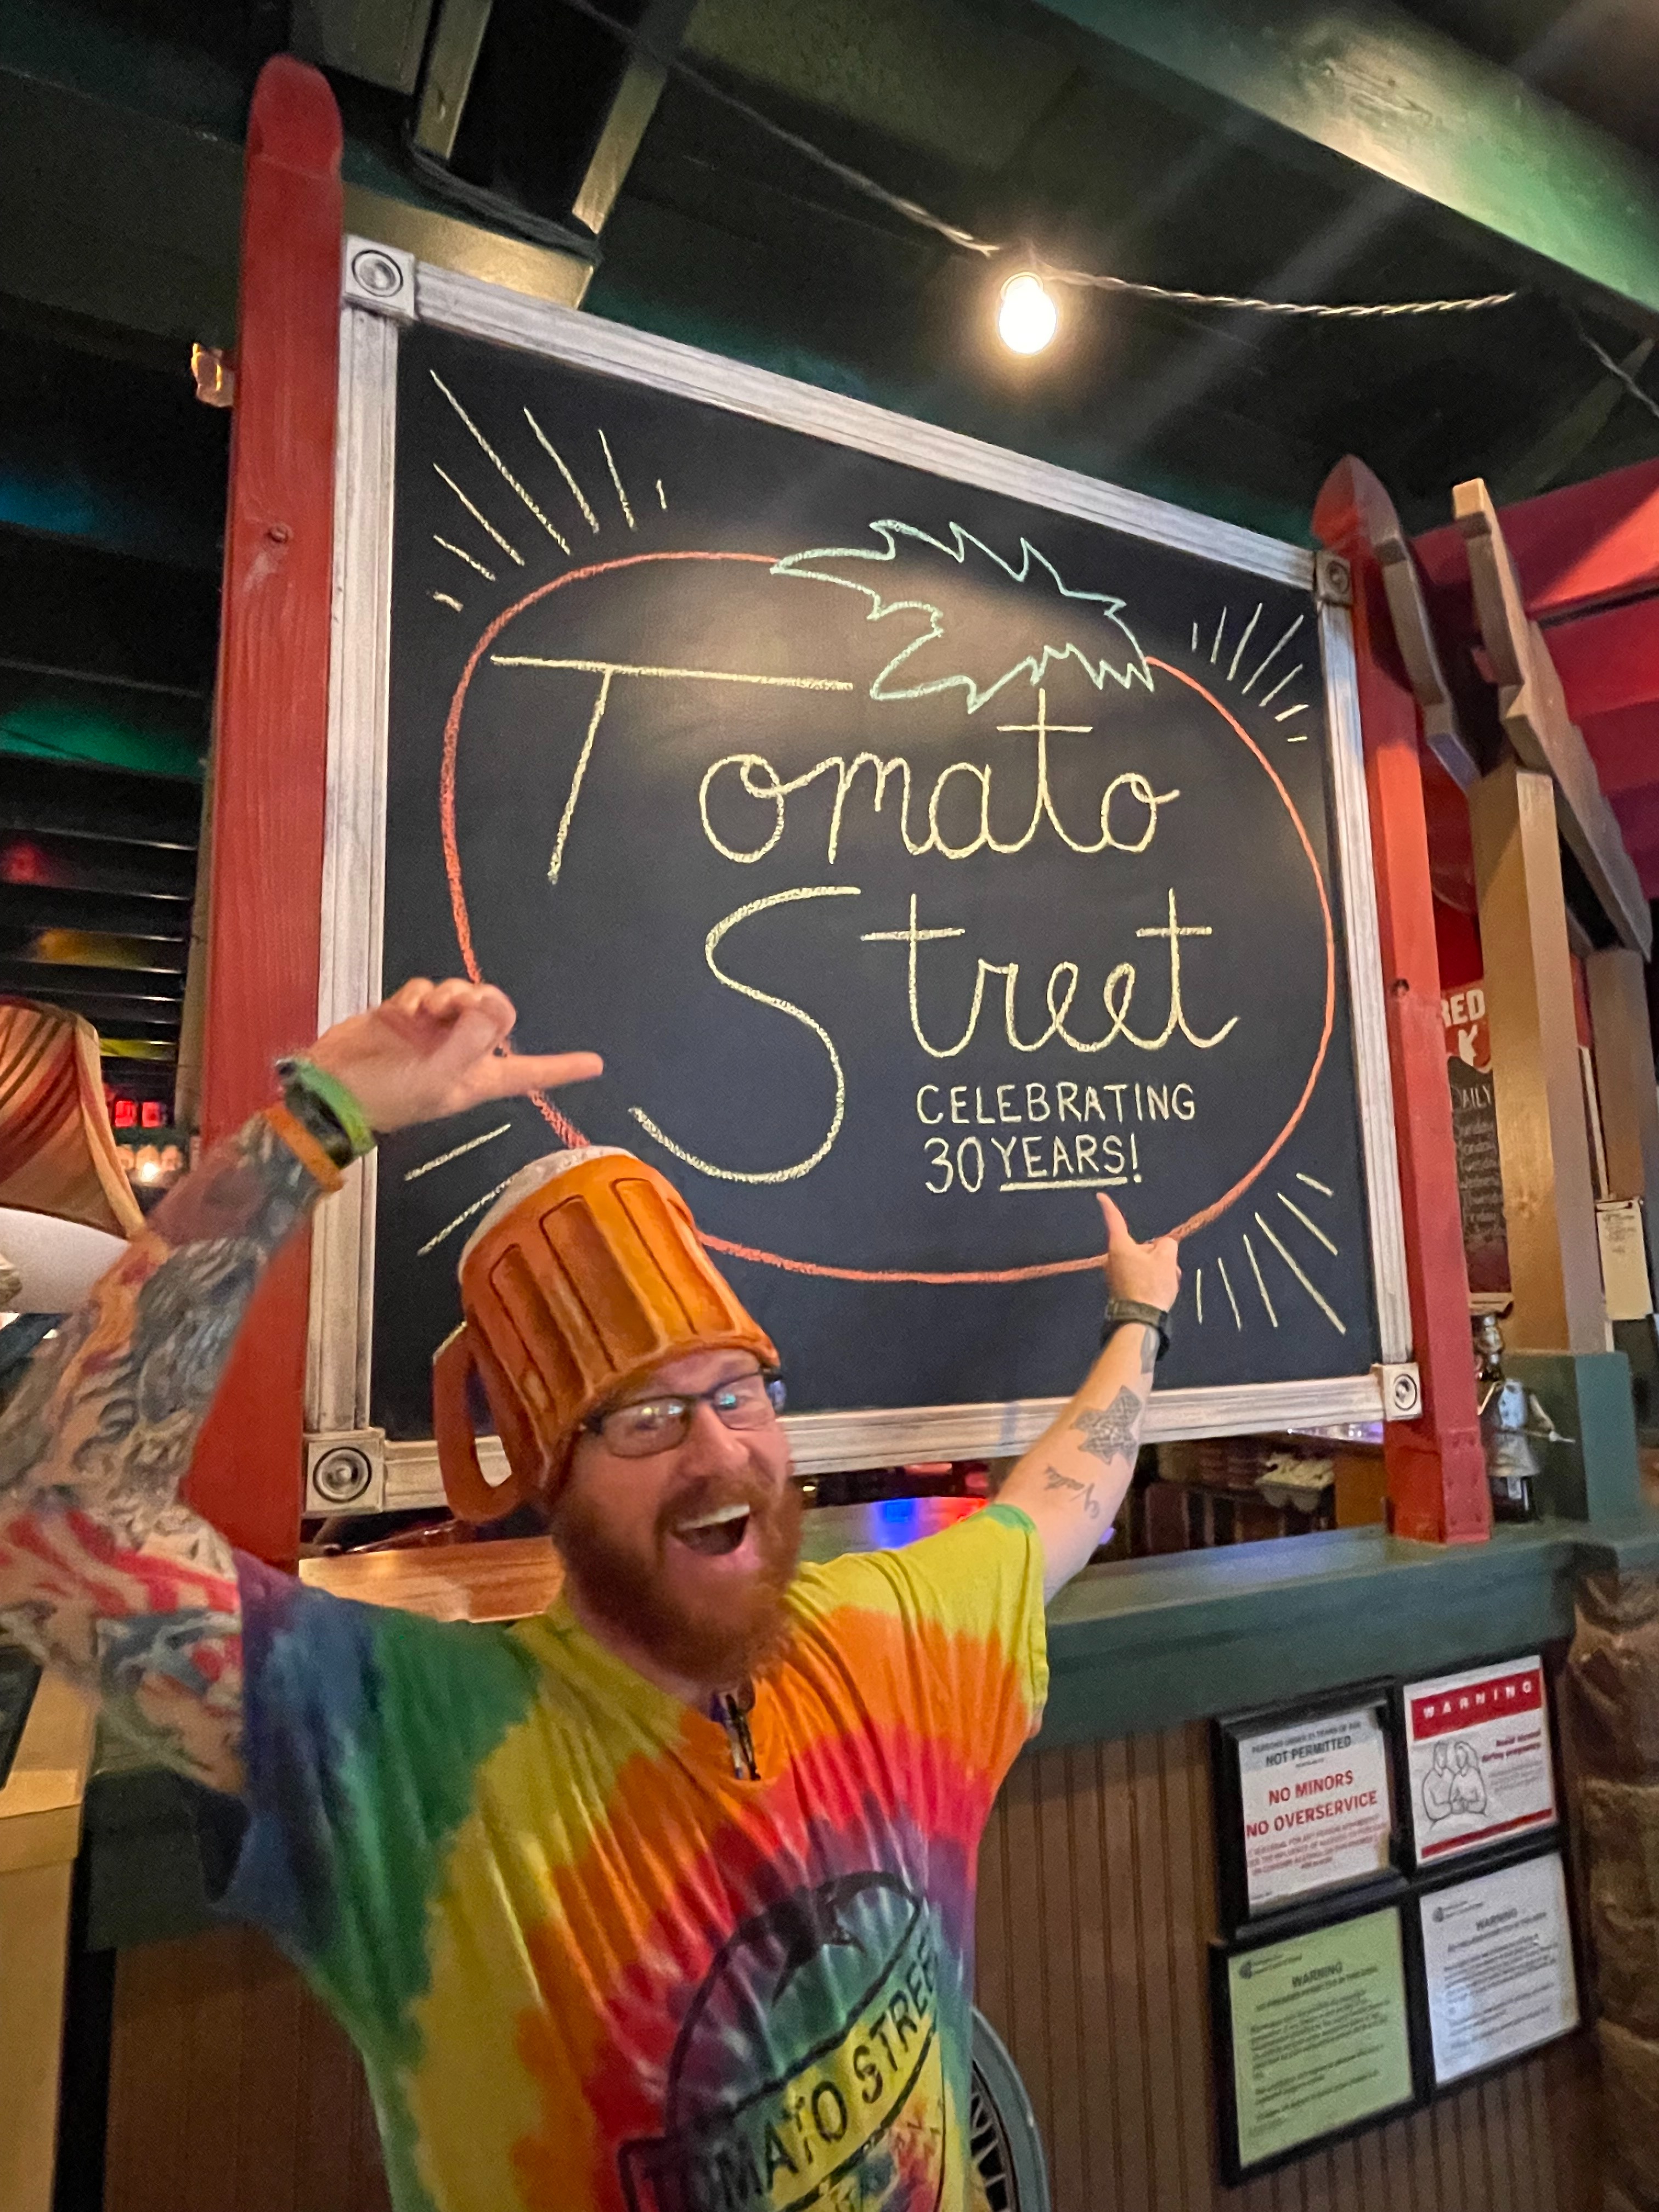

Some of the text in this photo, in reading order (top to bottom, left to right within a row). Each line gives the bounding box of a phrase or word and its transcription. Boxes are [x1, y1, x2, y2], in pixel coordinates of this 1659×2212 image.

[491, 654, 1180, 883] Tomato
[628, 887, 1240, 1183] Street
[916, 1081, 1196, 1125] CELEBRATING
[923, 1134, 1141, 1194] 30 YEARS!
[1423, 1680, 1532, 1719] WARNING
[1266, 1750, 1289, 1768] NOT
[1291, 1735, 1352, 1759] PERMITTED
[1268, 1770, 1354, 1806] NO MINORS
[1246, 1790, 1378, 1838] NO OVERSERVICE
[852, 1934, 938, 2104] STREE
